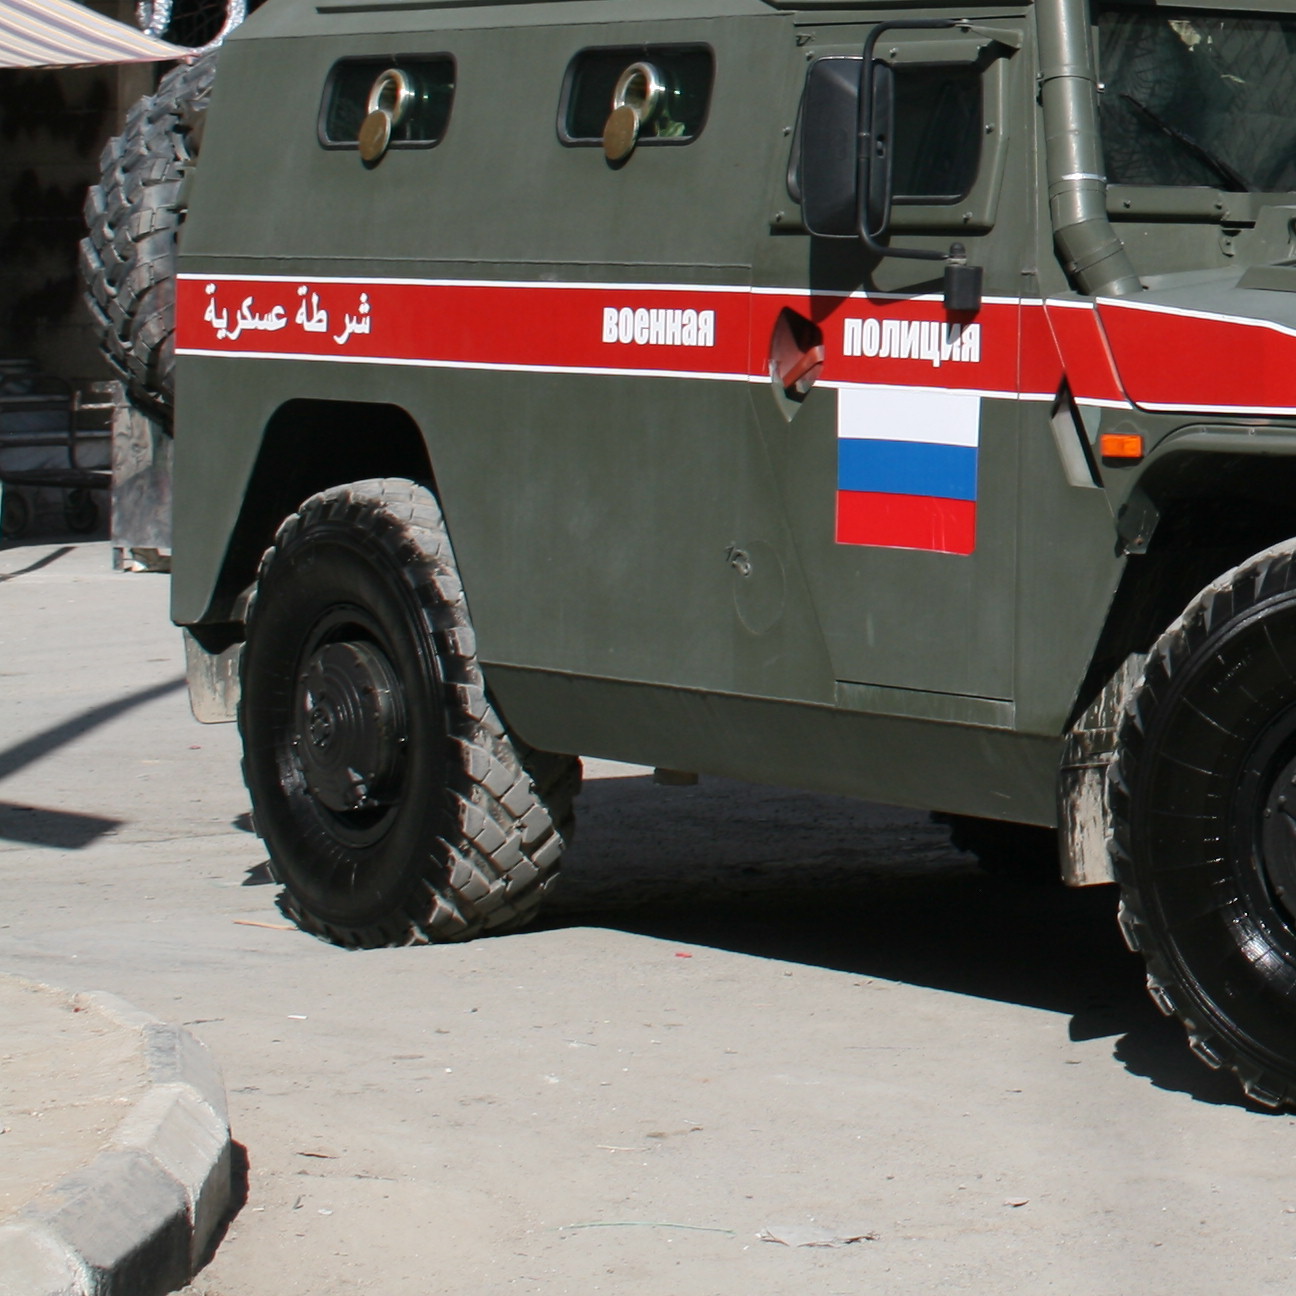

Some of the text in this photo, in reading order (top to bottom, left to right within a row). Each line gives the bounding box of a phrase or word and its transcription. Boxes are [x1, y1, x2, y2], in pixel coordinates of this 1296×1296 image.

[203, 282, 372, 345] شرطة عسكرية
[601, 306, 716, 347] военная
[843, 317, 982, 369] полиция
